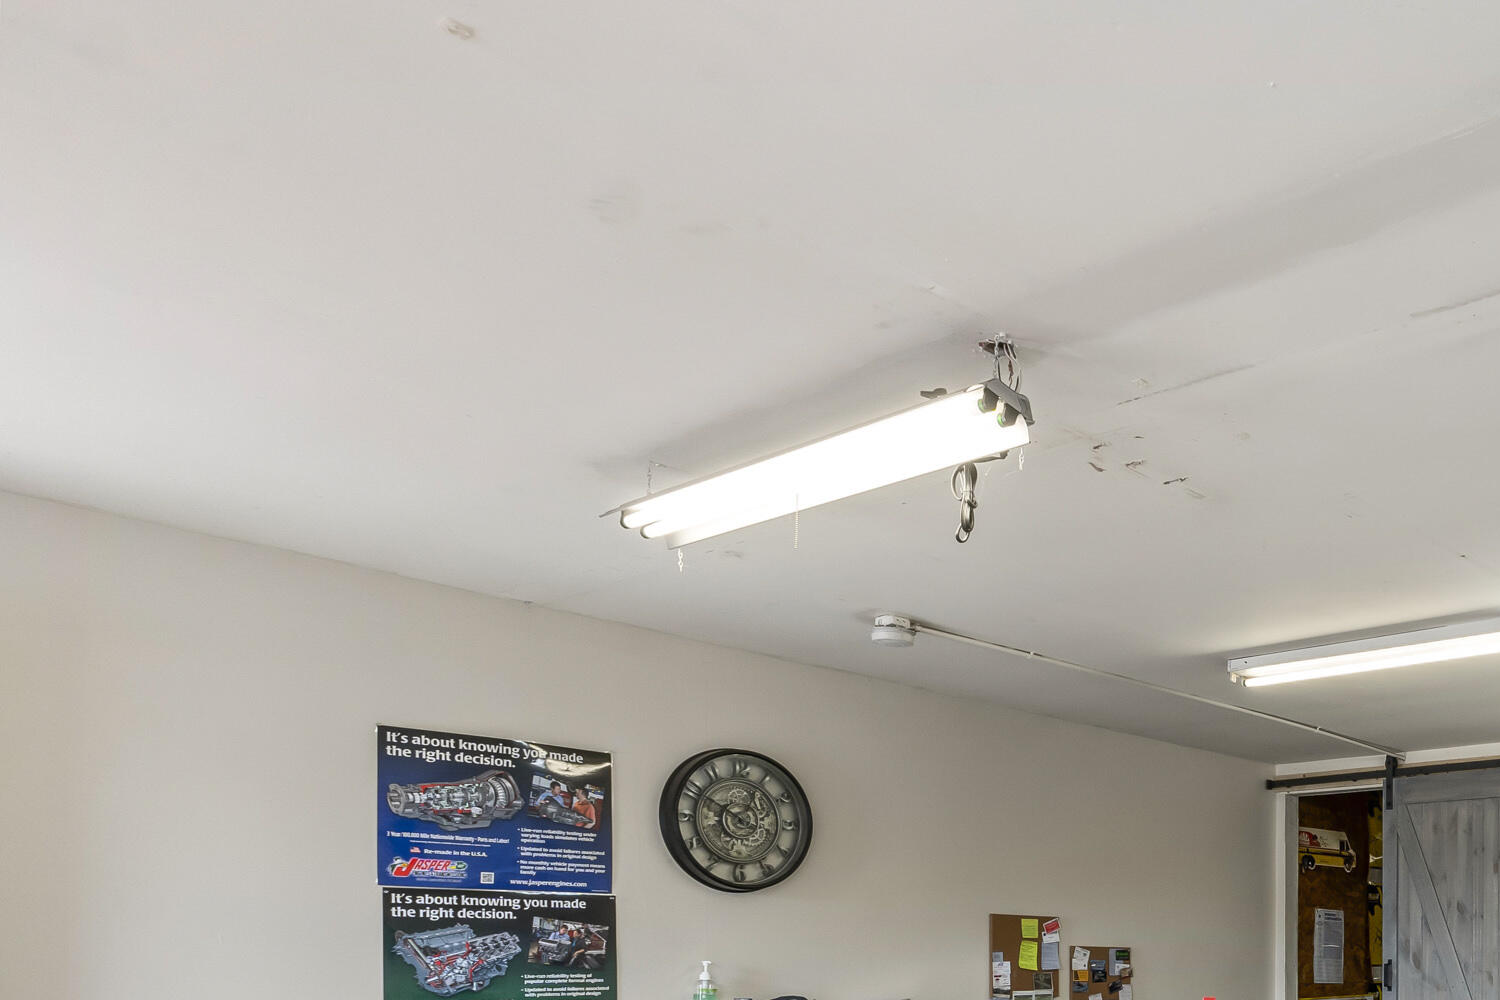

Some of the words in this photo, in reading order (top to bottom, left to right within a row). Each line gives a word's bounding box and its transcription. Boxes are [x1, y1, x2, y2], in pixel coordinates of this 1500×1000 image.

[386, 731, 408, 744] It's
[412, 735, 456, 749] about
[458, 739, 520, 759] knowing
[522, 748, 548, 760] you
[550, 752, 584, 764] made
[386, 745, 412, 758] the
[415, 748, 452, 762] right
[454, 752, 516, 768] decision.
[393, 857, 452, 878] JASPER
[510, 879, 588, 888] www.jasperengines.com
[390, 893, 412, 904] It's
[415, 894, 458, 905] about
[461, 894, 521, 910] knowing
[524, 898, 548, 910] you
[550, 898, 587, 909] made
[390, 906, 416, 918] the
[419, 907, 454, 921] right
[457, 908, 517, 919] decision.
